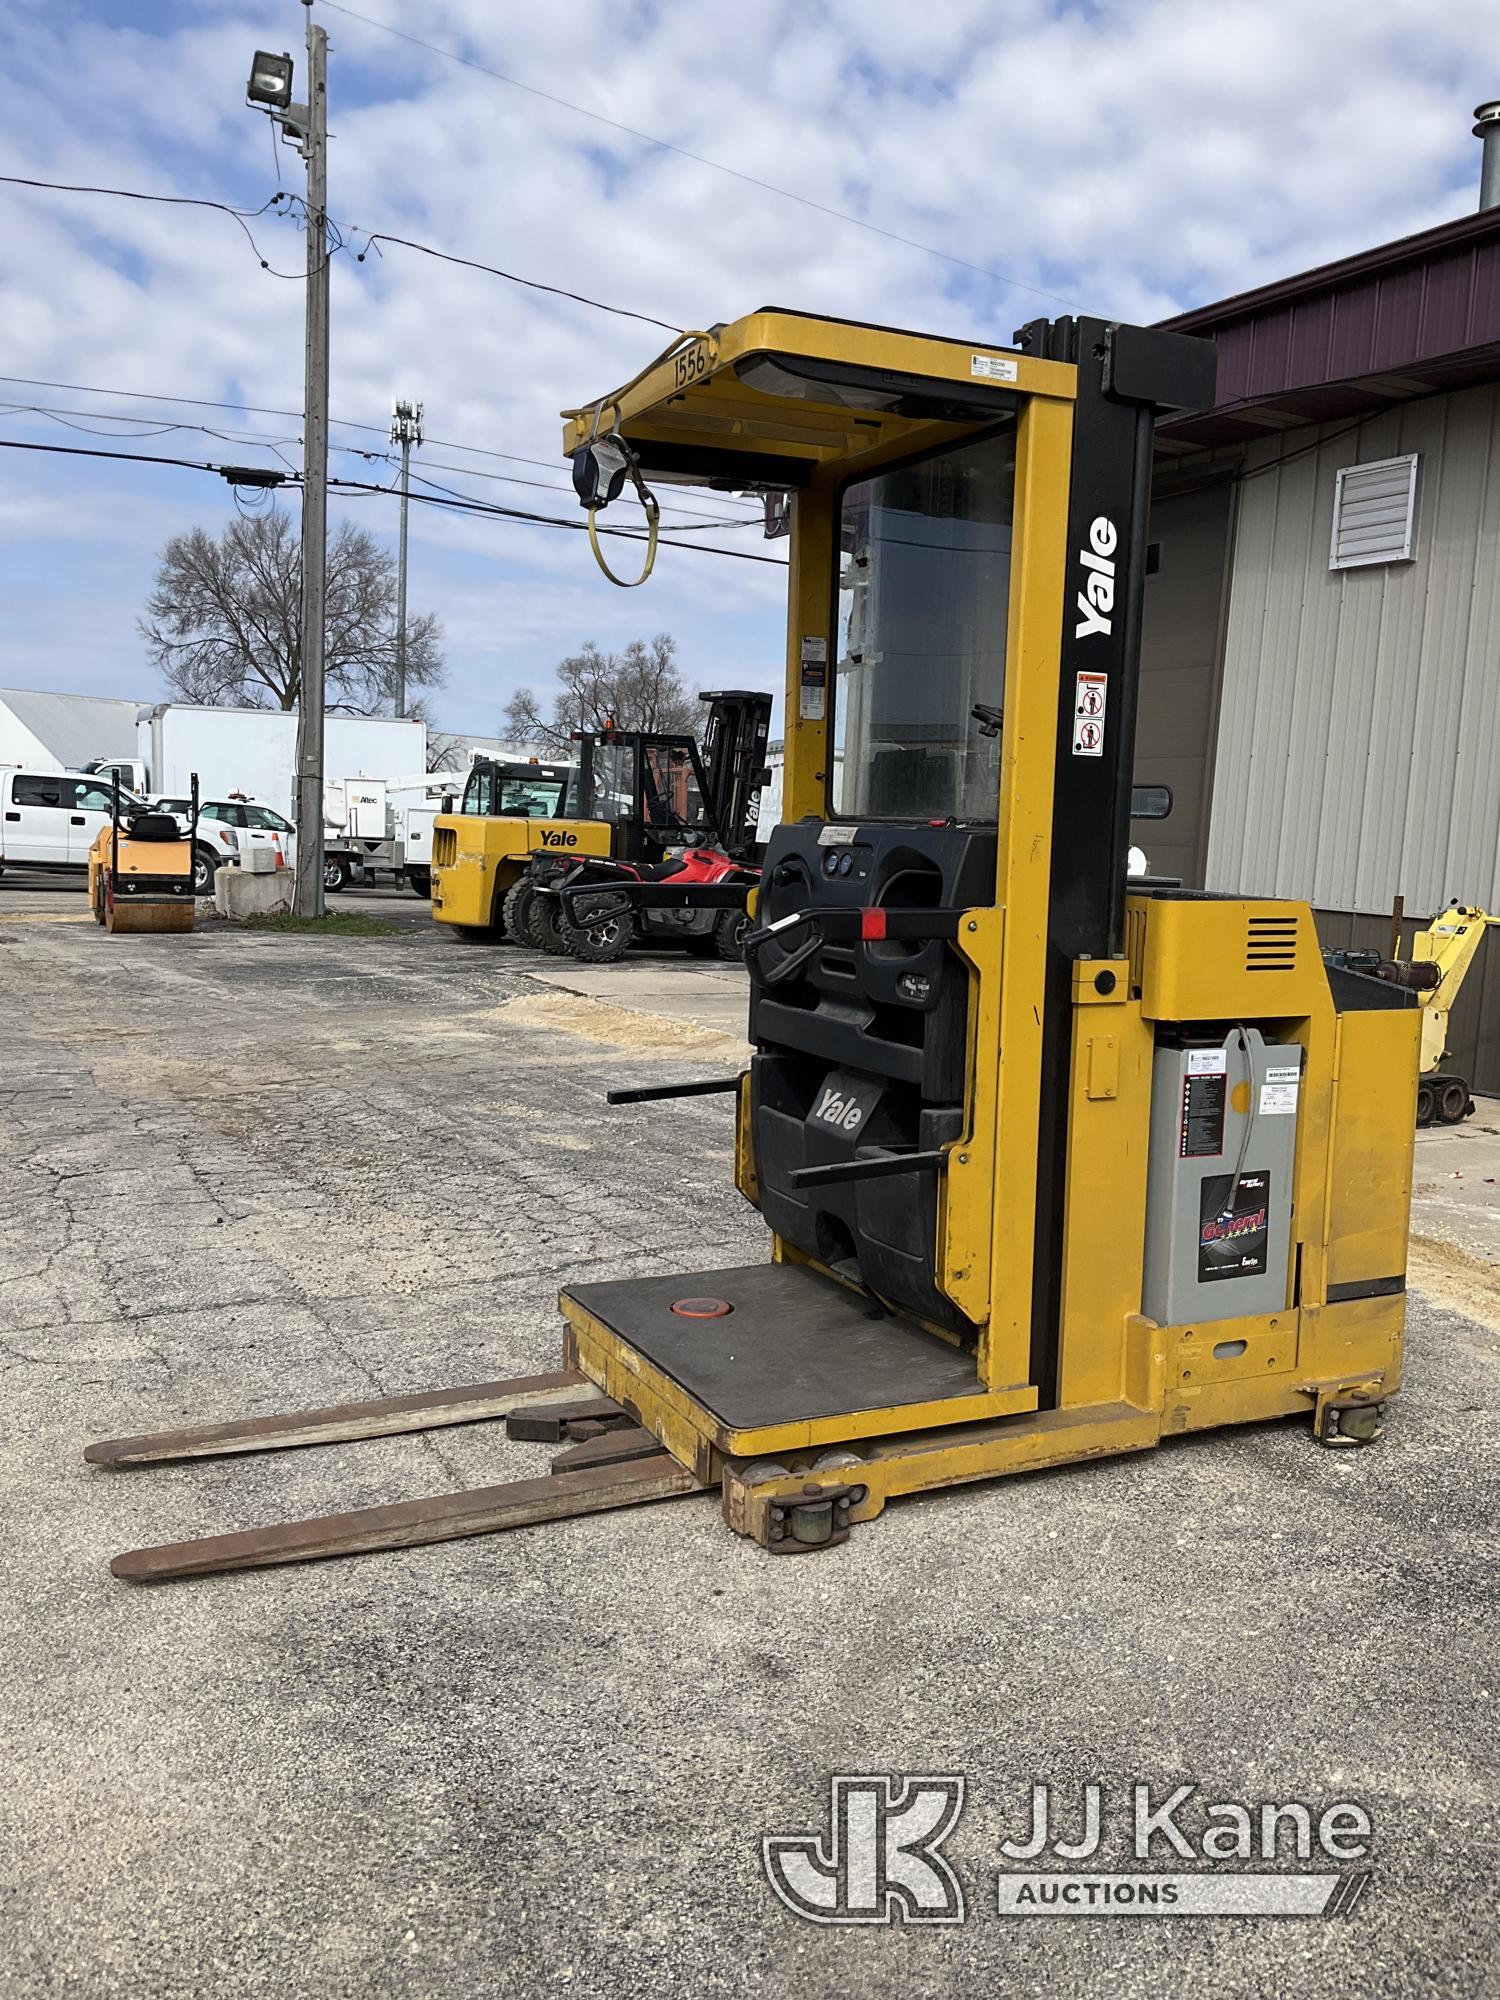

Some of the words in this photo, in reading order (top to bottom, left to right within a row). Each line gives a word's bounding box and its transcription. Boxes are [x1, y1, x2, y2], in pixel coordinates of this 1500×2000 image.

[675, 344, 705, 389] 1556
[1075, 516, 1118, 639] Yale
[360, 796, 377, 804] Altec
[744, 790, 761, 827] Yale
[540, 830, 577, 847] Yale
[816, 1088, 862, 1130] Yale
